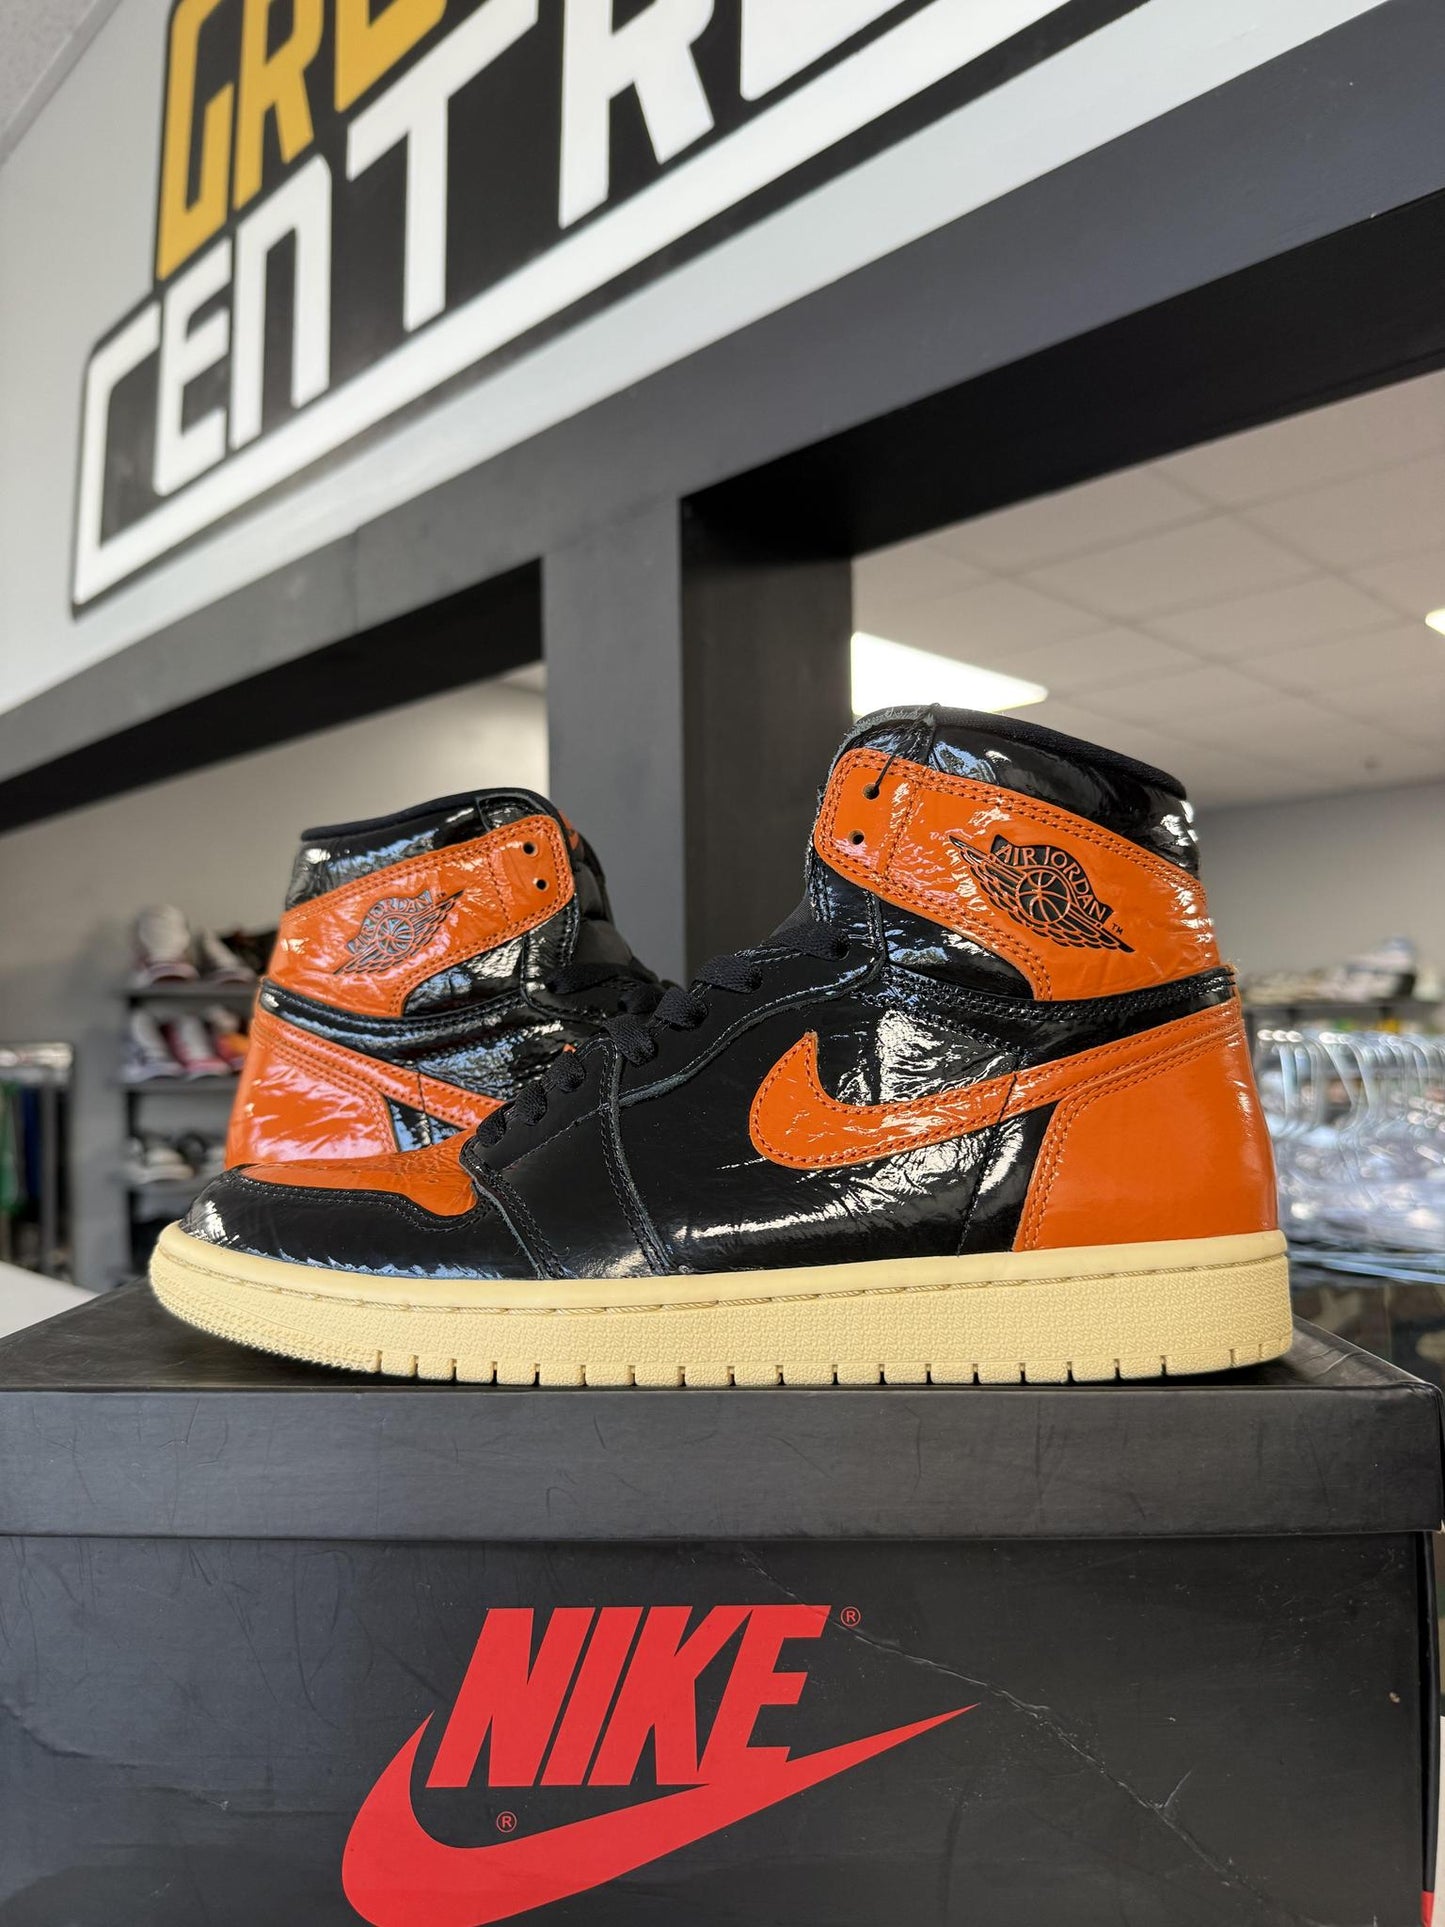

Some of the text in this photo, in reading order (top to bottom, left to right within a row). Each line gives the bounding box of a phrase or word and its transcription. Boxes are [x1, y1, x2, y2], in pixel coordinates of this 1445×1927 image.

[995, 844, 1106, 920] AIR JORDAN
[425, 1604, 831, 1788] NIKE
